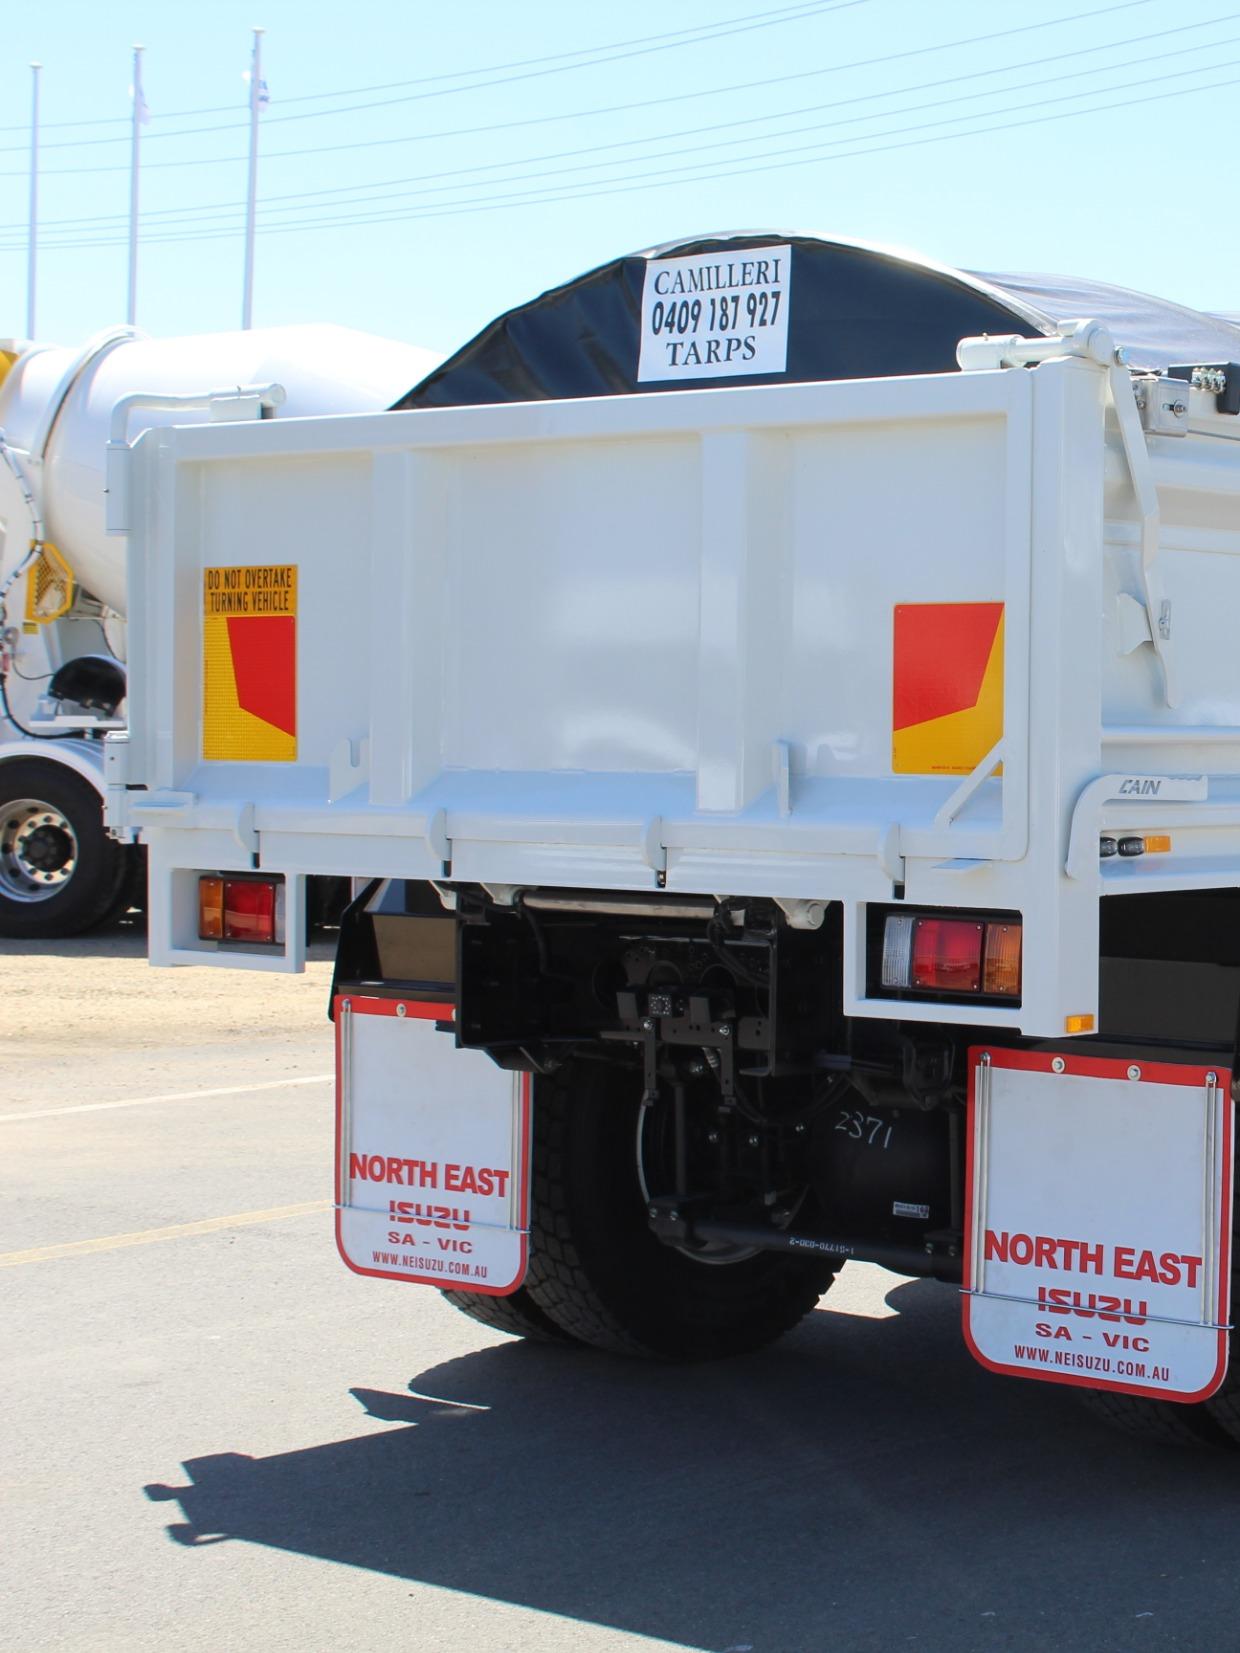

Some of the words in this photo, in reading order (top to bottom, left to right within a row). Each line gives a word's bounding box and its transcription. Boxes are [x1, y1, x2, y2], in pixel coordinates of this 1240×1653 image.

[654, 259, 781, 295] CAMILLERI
[652, 299, 702, 335] 0409
[709, 295, 740, 331] 187
[746, 291, 781, 328] 927
[666, 335, 756, 367] TARPS
[208, 570, 219, 590] DO
[224, 569, 242, 589] NOT
[245, 568, 292, 589] OVERTAKE
[210, 591, 248, 612] TURNING
[252, 590, 289, 612] VEHICLE
[1118, 779, 1162, 795] CAIN
[349, 1152, 438, 1189] NORTH
[444, 1163, 510, 1198] EAST
[389, 1200, 471, 1231] ISUZU
[387, 1231, 416, 1246] SA
[437, 1237, 473, 1254] VIC
[372, 1251, 488, 1278] WWW.NEISUZU.COM.AU
[984, 1229, 1104, 1276] NORTH
[1113, 1246, 1203, 1289] EAST
[1037, 1286, 1147, 1326] ISUZU
[1034, 1323, 1073, 1341] SA
[1101, 1332, 1150, 1352] VIC
[1014, 1345, 1170, 1382] WWW.NEISUZU.COM.AU
